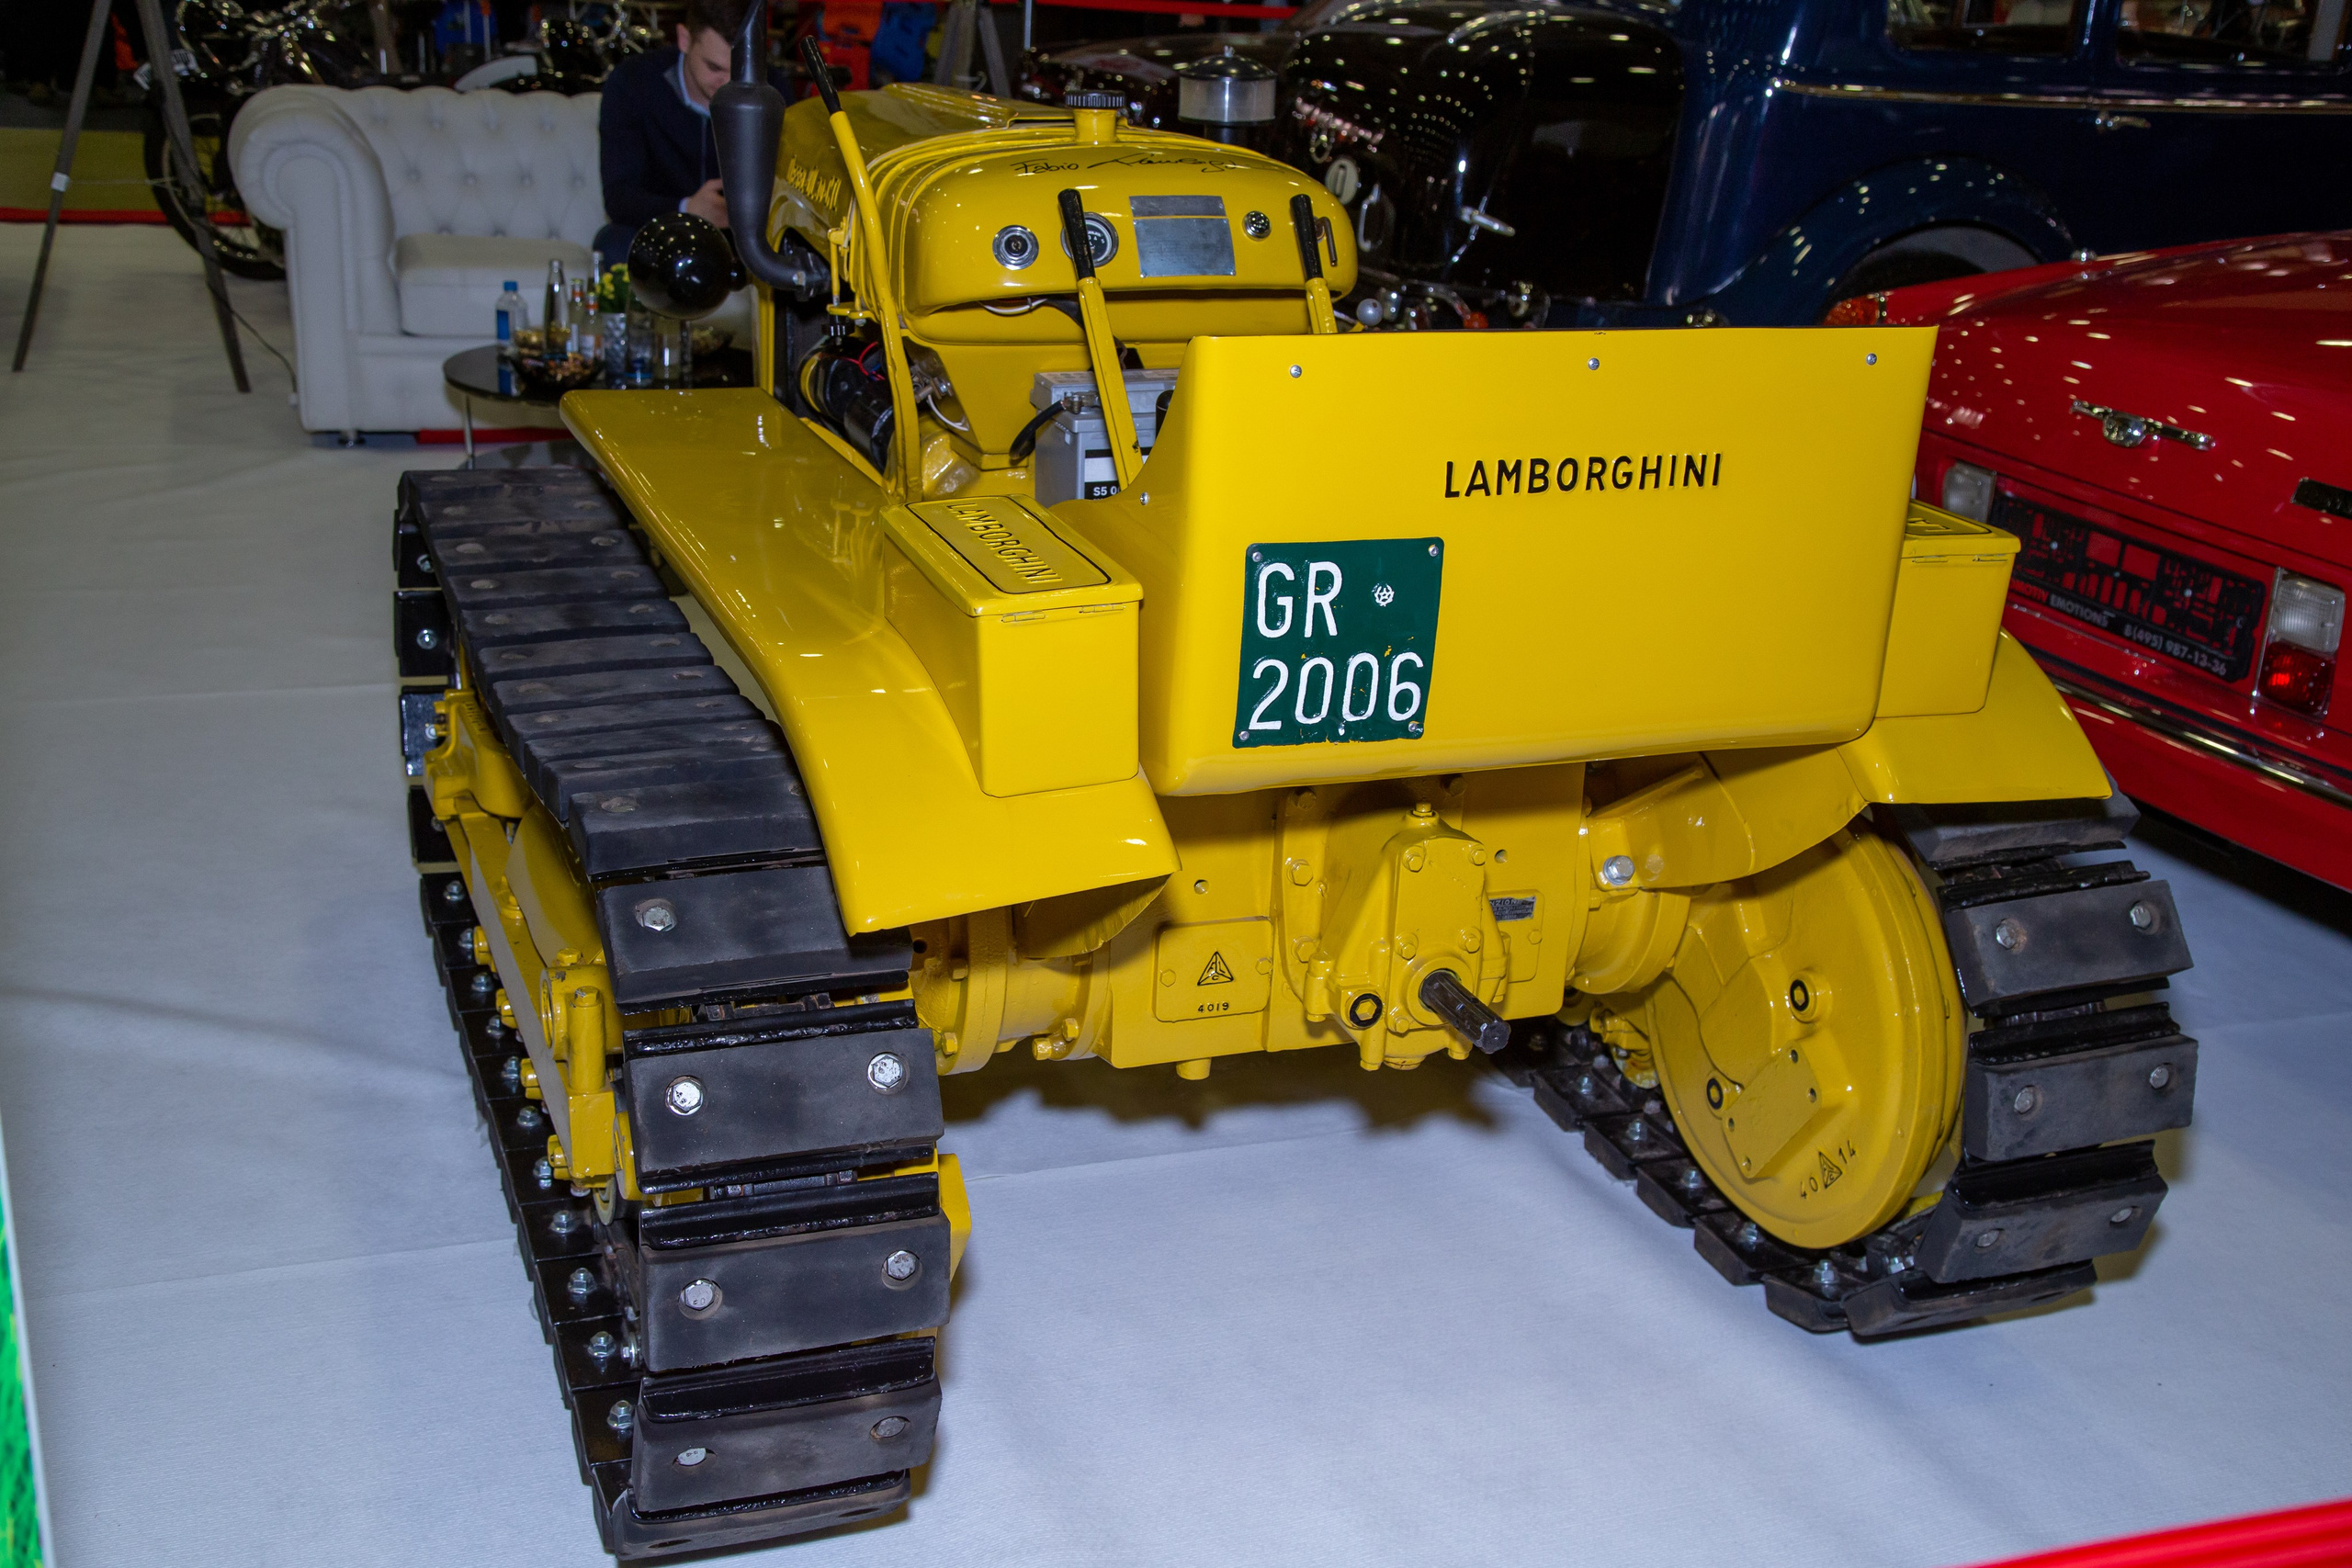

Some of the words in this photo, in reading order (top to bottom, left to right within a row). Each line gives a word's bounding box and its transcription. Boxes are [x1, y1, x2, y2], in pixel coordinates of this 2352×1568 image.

[1092, 486, 1108, 497] S5
[1110, 486, 1120, 496] 0
[1444, 453, 1722, 498] LAMBORGHINI
[946, 502, 1063, 584] LAMBORGHINI
[1257, 561, 1343, 638] GR
[2049, 594, 2109, 628] EMOTIONS
[1249, 651, 1424, 730] 2006
[1197, 1002, 1229, 1012] 4019
